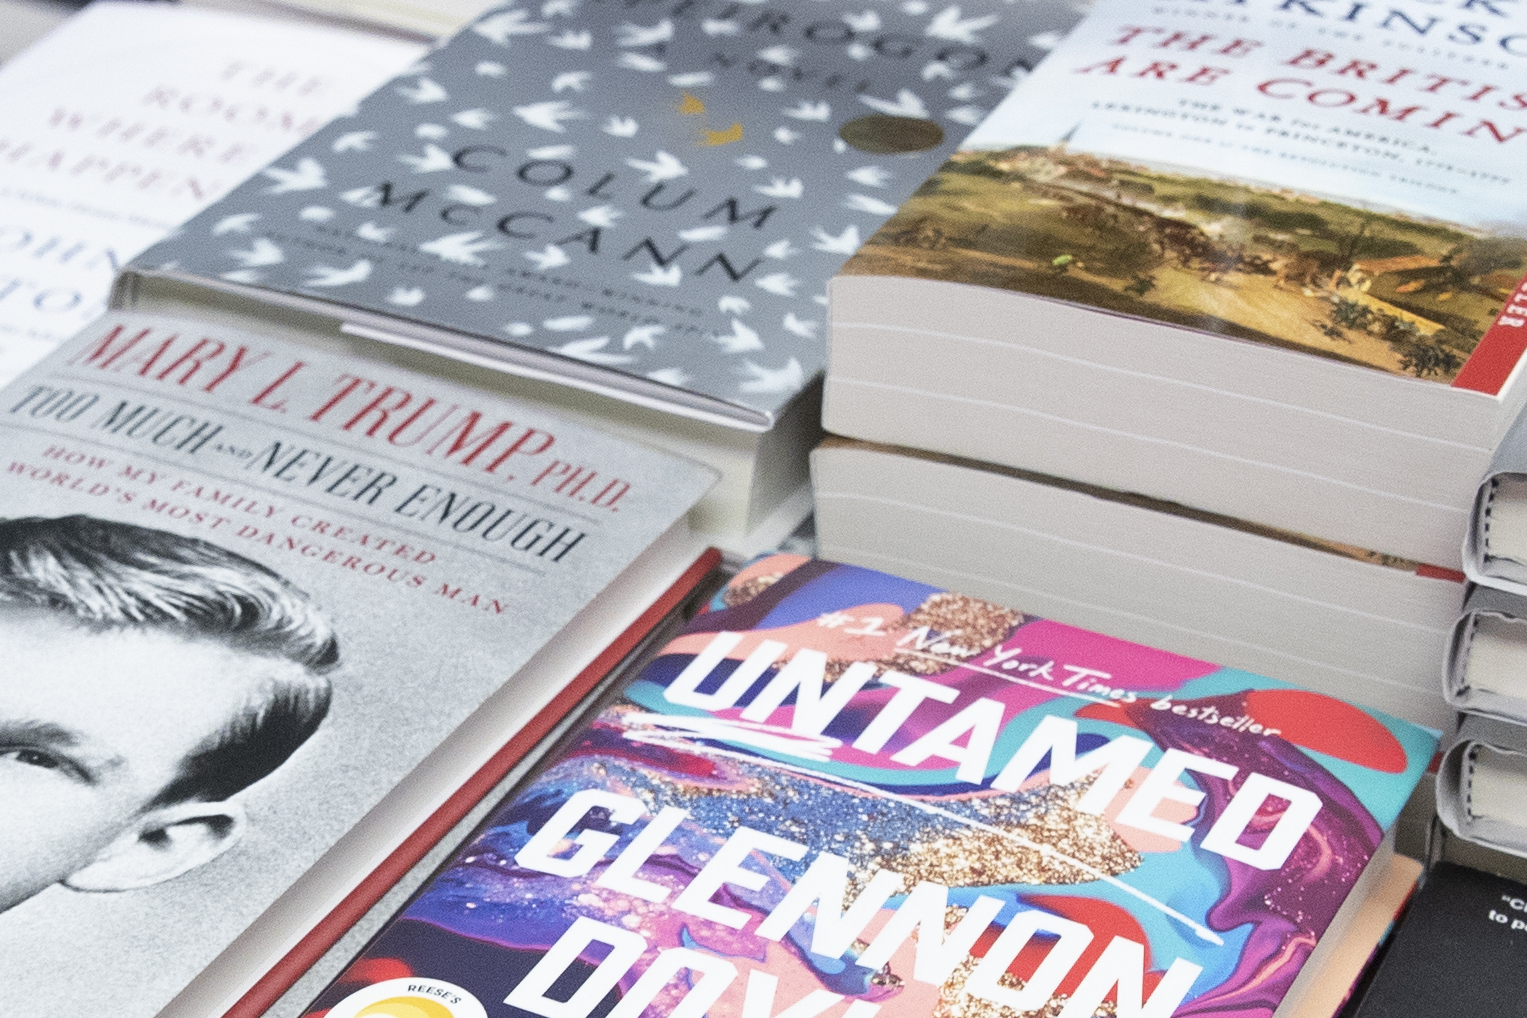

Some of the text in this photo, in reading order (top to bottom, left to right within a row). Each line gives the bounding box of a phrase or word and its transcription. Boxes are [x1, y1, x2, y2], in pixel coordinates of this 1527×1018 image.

[1071, 55, 1527, 146] ARE COMIN
[1108, 25, 1265, 58] THE
[453, 143, 781, 234] COLUM
[69, 322, 273, 395] MARY
[252, 358, 309, 417] L.
[306, 371, 558, 482] TRUMP,
[10, 382, 103, 426] TOO
[90, 399, 221, 459] MUCH
[249, 439, 402, 507] NEVER
[392, 482, 589, 566] ENOUGH
[40, 444, 438, 568] HOW MY FAMILY CREATED
[141, 498, 235, 534] MOST
[237, 519, 430, 590] DANGEROUS
[430, 581, 514, 617] MAN
[892, 623, 983, 666] New
[982, 640, 1059, 687] York
[1061, 662, 1144, 708] Times
[1149, 689, 1284, 742] bestseller
[662, 630, 1325, 873] UNTAMED
